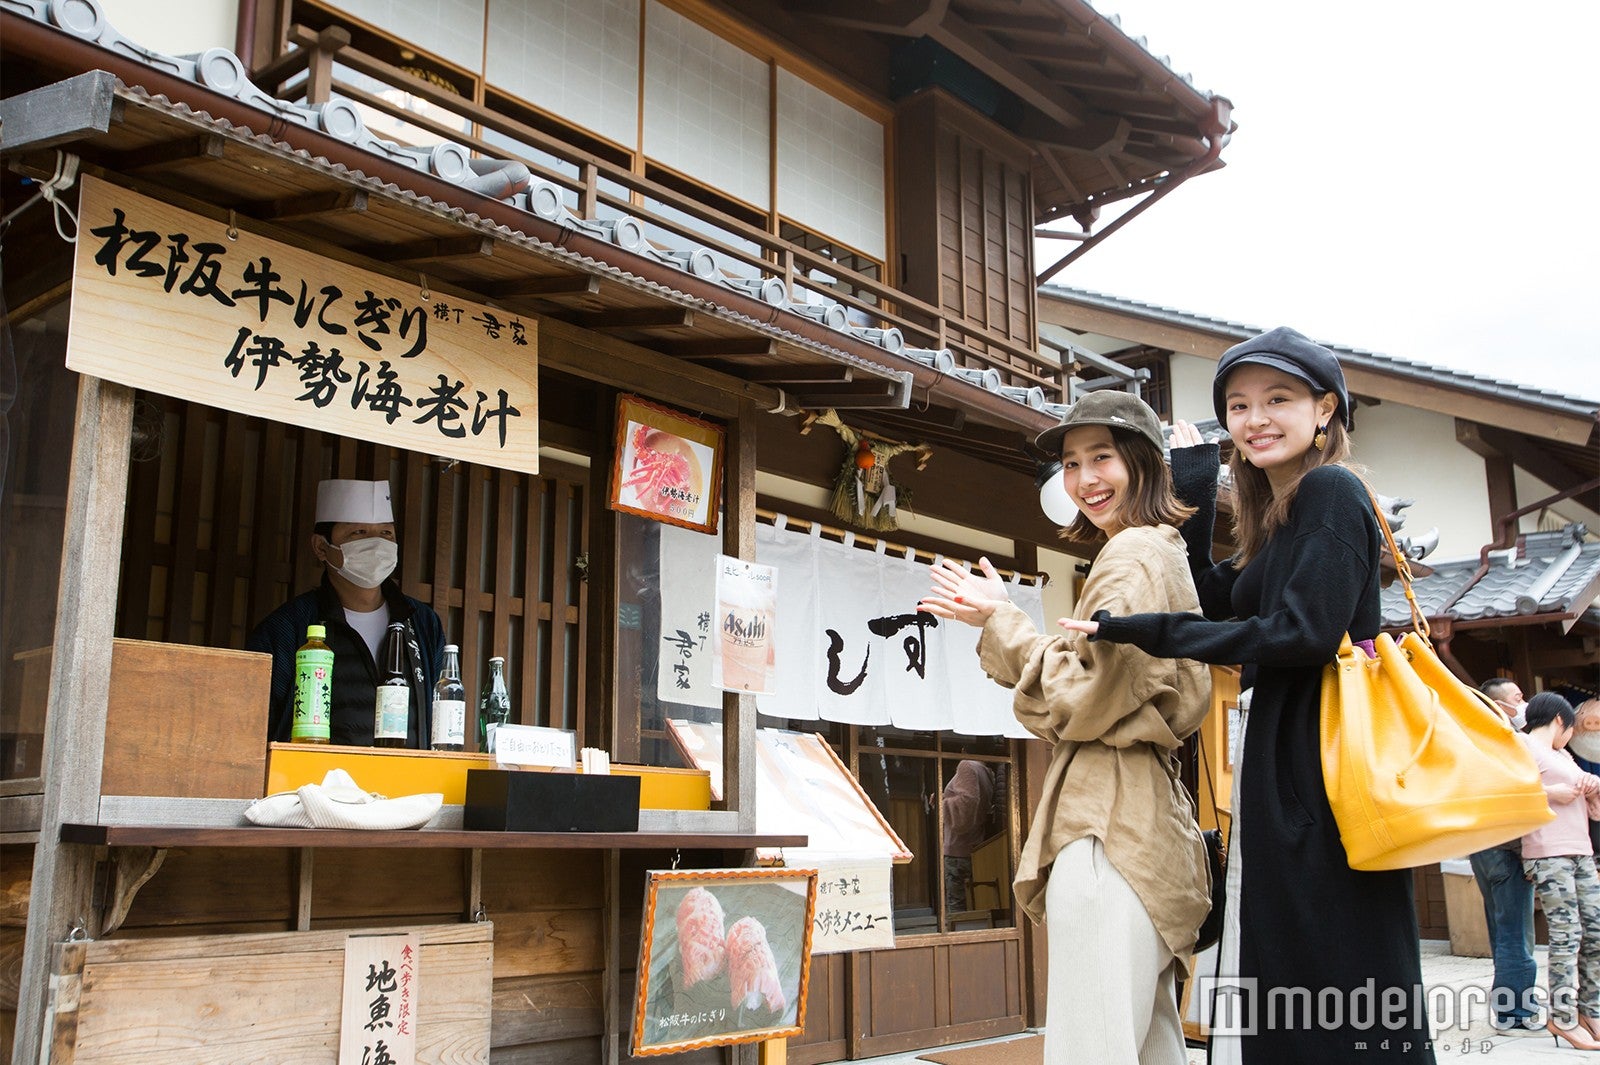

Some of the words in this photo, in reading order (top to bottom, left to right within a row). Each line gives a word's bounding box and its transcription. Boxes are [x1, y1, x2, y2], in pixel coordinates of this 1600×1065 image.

[90, 207, 428, 359] 松阪牛にぎり
[433, 302, 465, 325] 横丁
[224, 327, 522, 449] 伊勢海老汁
[661, 485, 700, 505] 伊勢海老汁
[669, 503, 695, 519] 500円
[697, 610, 711, 652] 横丁
[723, 609, 766, 639] Asahi
[397, 944, 413, 1036] 食べ歩き限定
[658, 1007, 727, 1028] 松阪牛のにぎり
